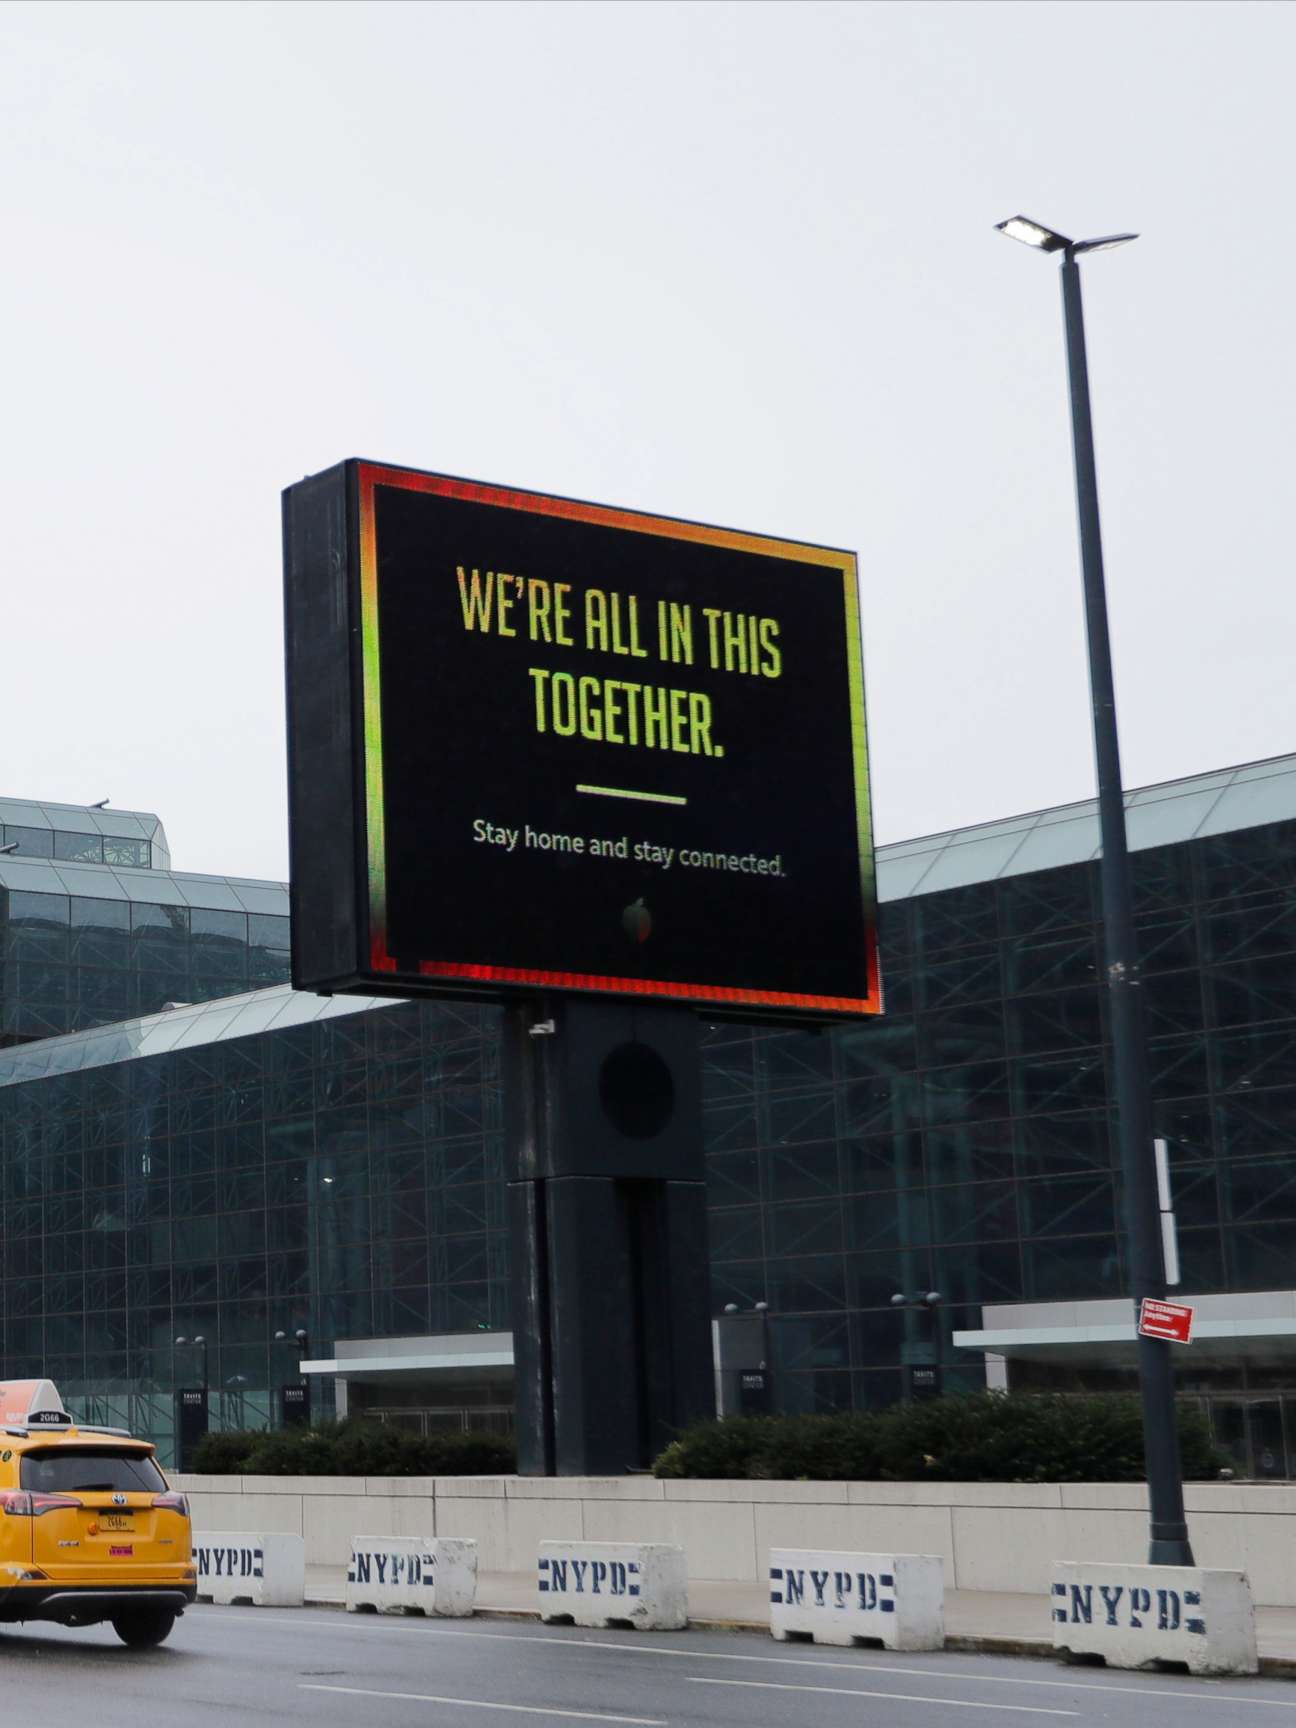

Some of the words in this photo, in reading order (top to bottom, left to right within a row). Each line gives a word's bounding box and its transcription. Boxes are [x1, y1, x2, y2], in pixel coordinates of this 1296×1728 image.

[456, 566, 574, 646] WE'RE
[585, 589, 648, 657] ALL
[658, 601, 694, 665] IN
[702, 608, 781, 678] THIS
[529, 668, 725, 757] TOGETHER.
[473, 819, 519, 852] Stay
[525, 825, 584, 853] home
[590, 837, 629, 859] and
[634, 841, 675, 869] stay
[679, 849, 786, 877] connected.
[198, 1548, 253, 1577] NYPD
[356, 1553, 422, 1586] NYPD
[551, 1559, 627, 1595] NYPD
[785, 1568, 877, 1612] NYPD
[1070, 1584, 1181, 1631] NYPD
